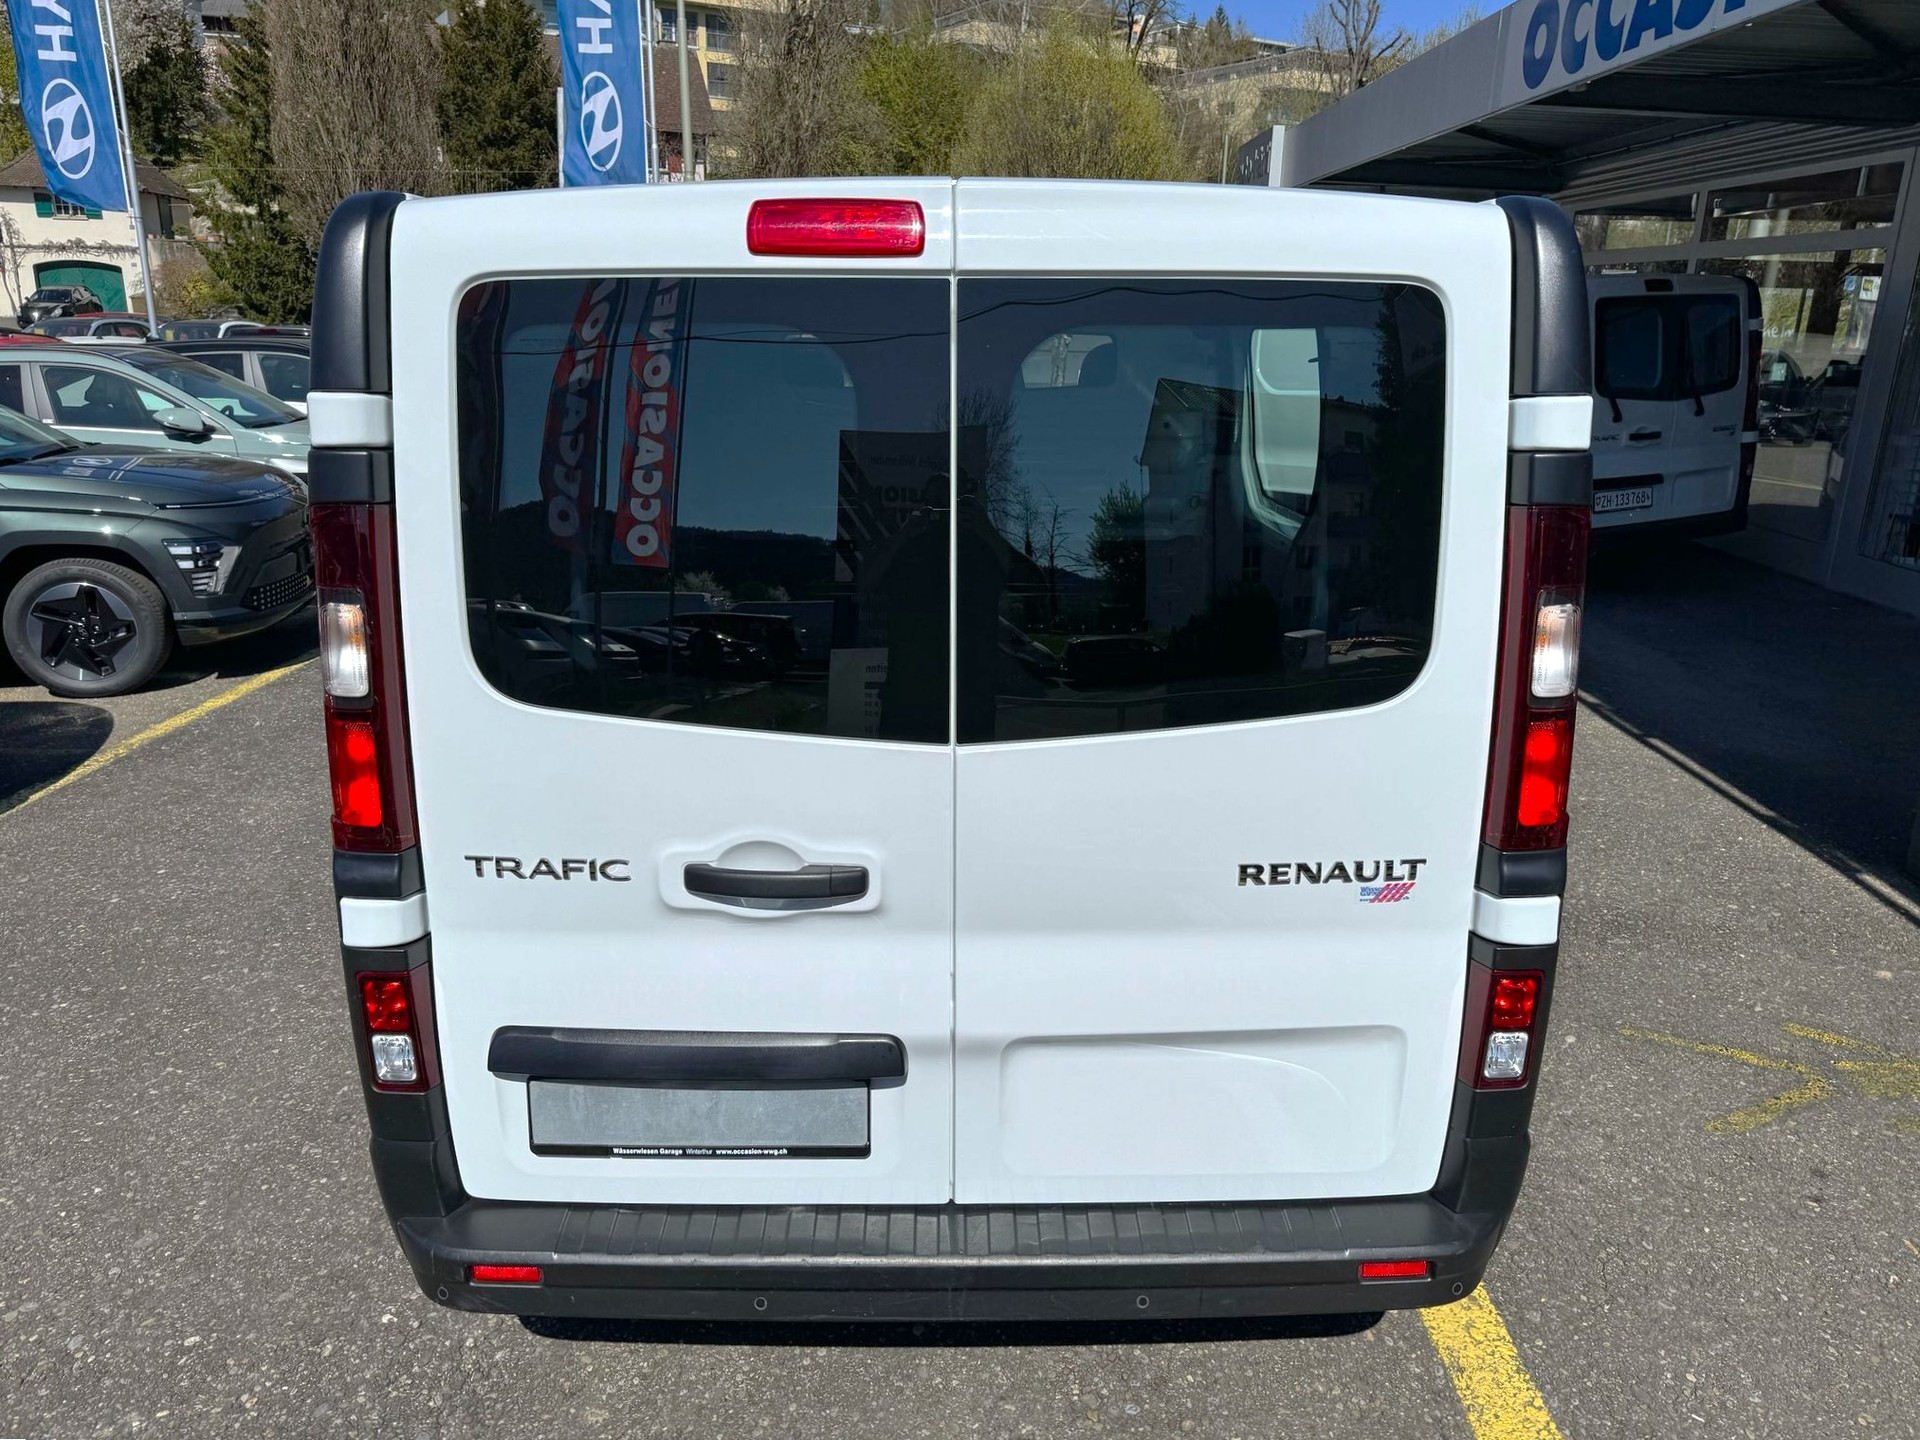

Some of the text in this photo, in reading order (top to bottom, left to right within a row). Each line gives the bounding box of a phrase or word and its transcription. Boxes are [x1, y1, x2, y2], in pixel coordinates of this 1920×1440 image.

[464, 855, 632, 882] TRAFIC
[1237, 858, 1427, 886] RENAULT
[659, 1147, 683, 1157] Garage
[685, 1147, 713, 1156] Winterthur
[715, 1147, 788, 1157] www.occasion-wwg.ch
